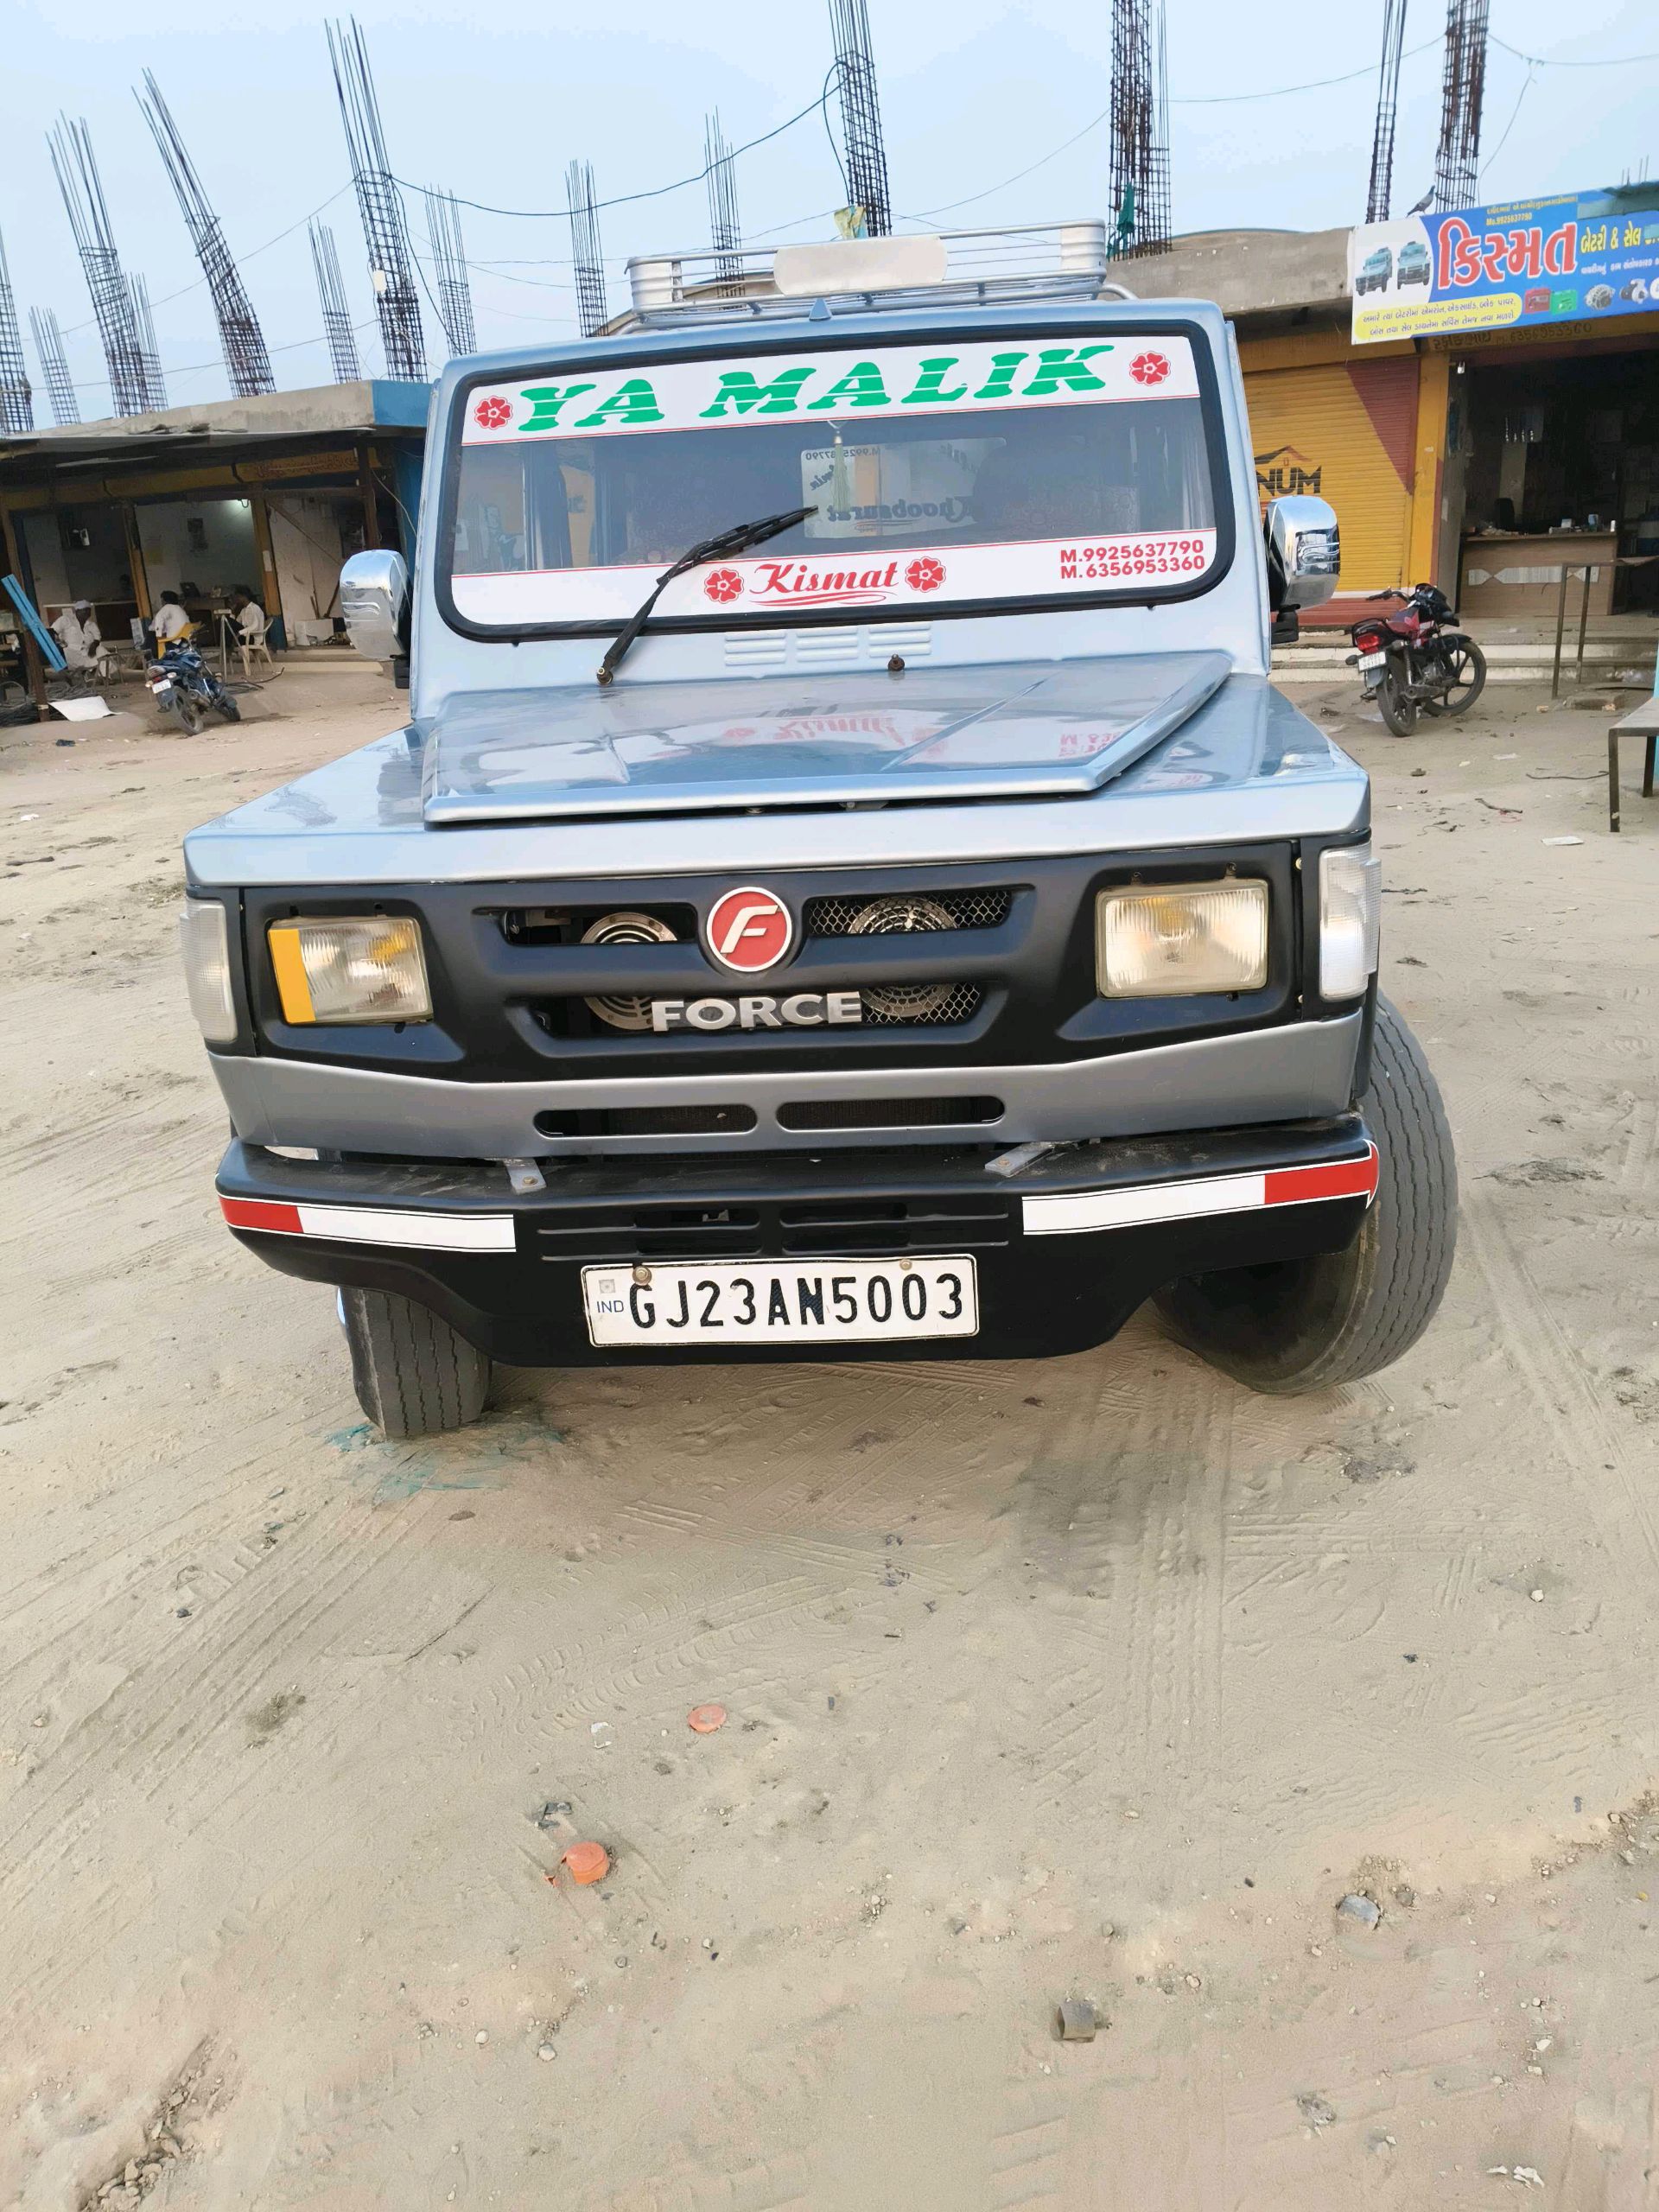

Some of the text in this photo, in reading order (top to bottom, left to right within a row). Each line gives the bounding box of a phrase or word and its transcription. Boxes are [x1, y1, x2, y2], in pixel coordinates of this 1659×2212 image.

[1580, 220, 1641, 253] બેટરી & સેલ
[518, 345, 1115, 431] YA MALIK
[1061, 539, 1204, 563] M.9925637790
[749, 562, 899, 594] Kismat
[720, 905, 779, 954] F
[652, 991, 862, 1032] FORCE
[597, 1273, 963, 1329] IND GJ23AN5003
